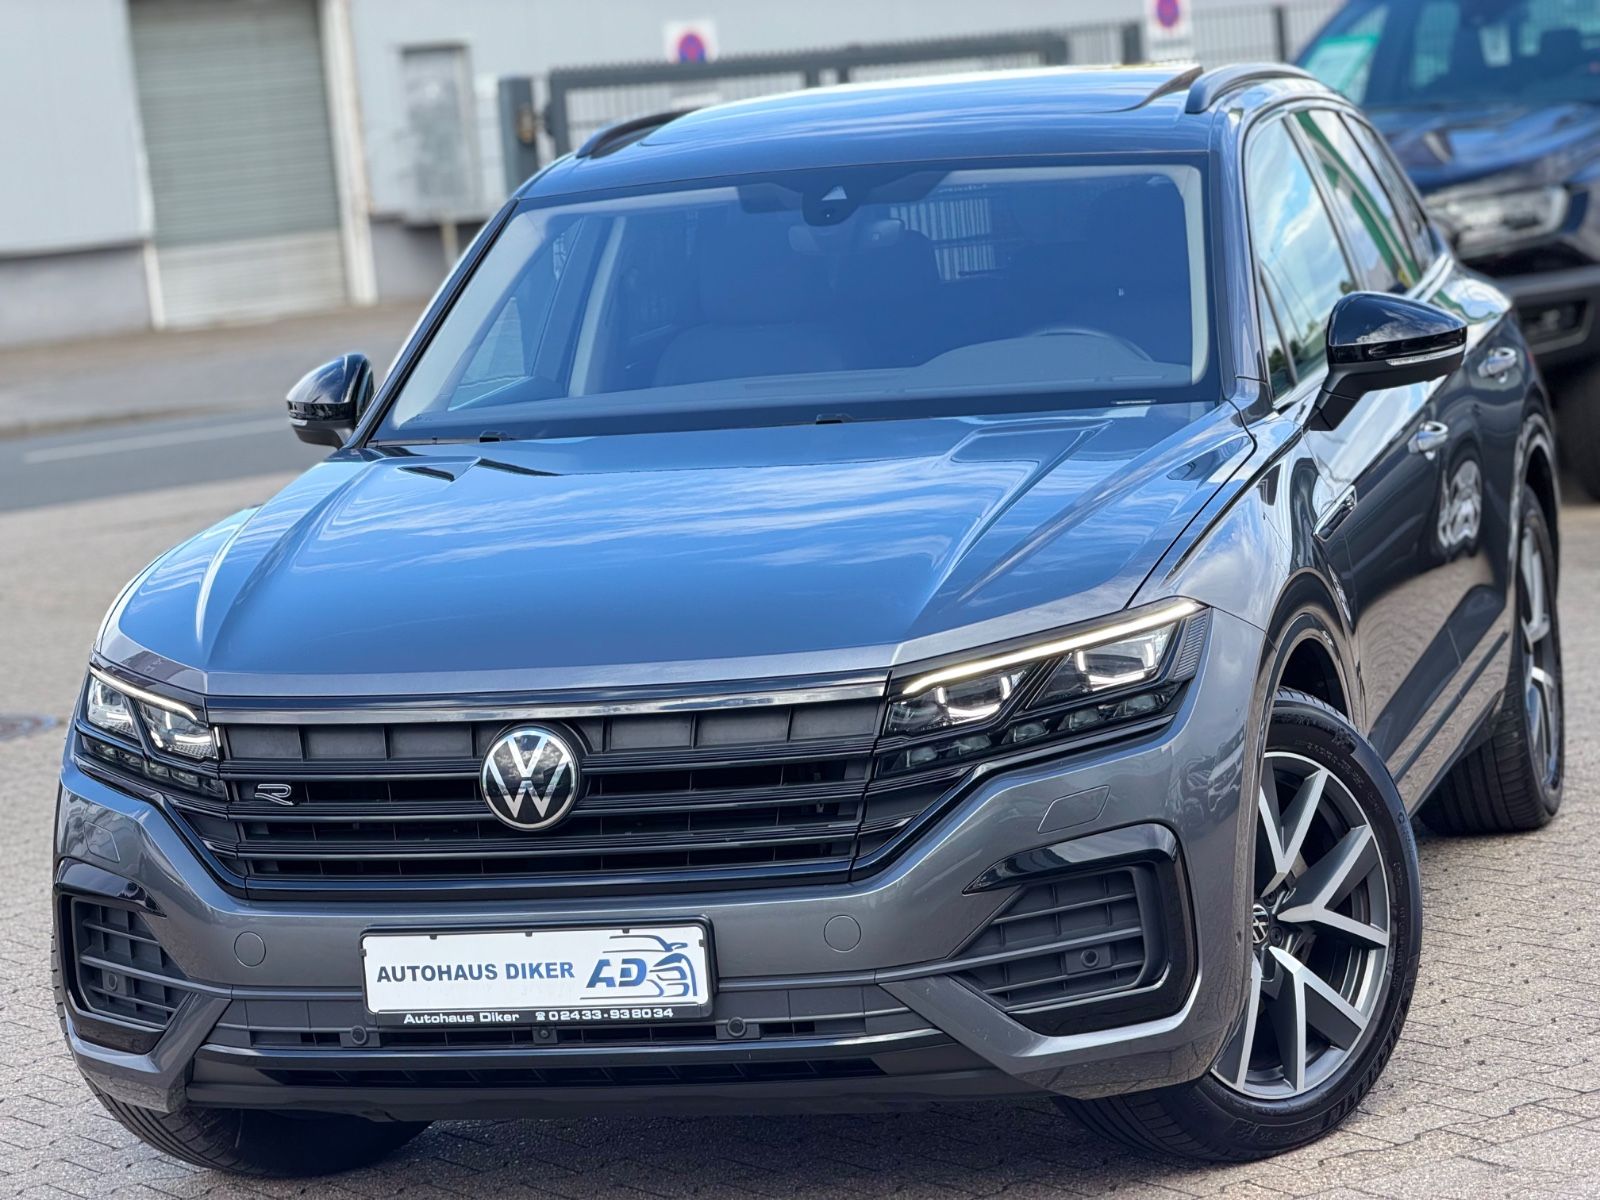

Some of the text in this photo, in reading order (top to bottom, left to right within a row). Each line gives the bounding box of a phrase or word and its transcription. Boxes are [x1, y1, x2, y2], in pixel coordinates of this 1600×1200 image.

[483, 730, 576, 828] VW
[255, 783, 294, 806] R
[376, 961, 576, 983] AUTOHAUS DIKER
[585, 957, 648, 989] AD
[403, 1007, 674, 1025] Autohaus Diker 02433-938034
